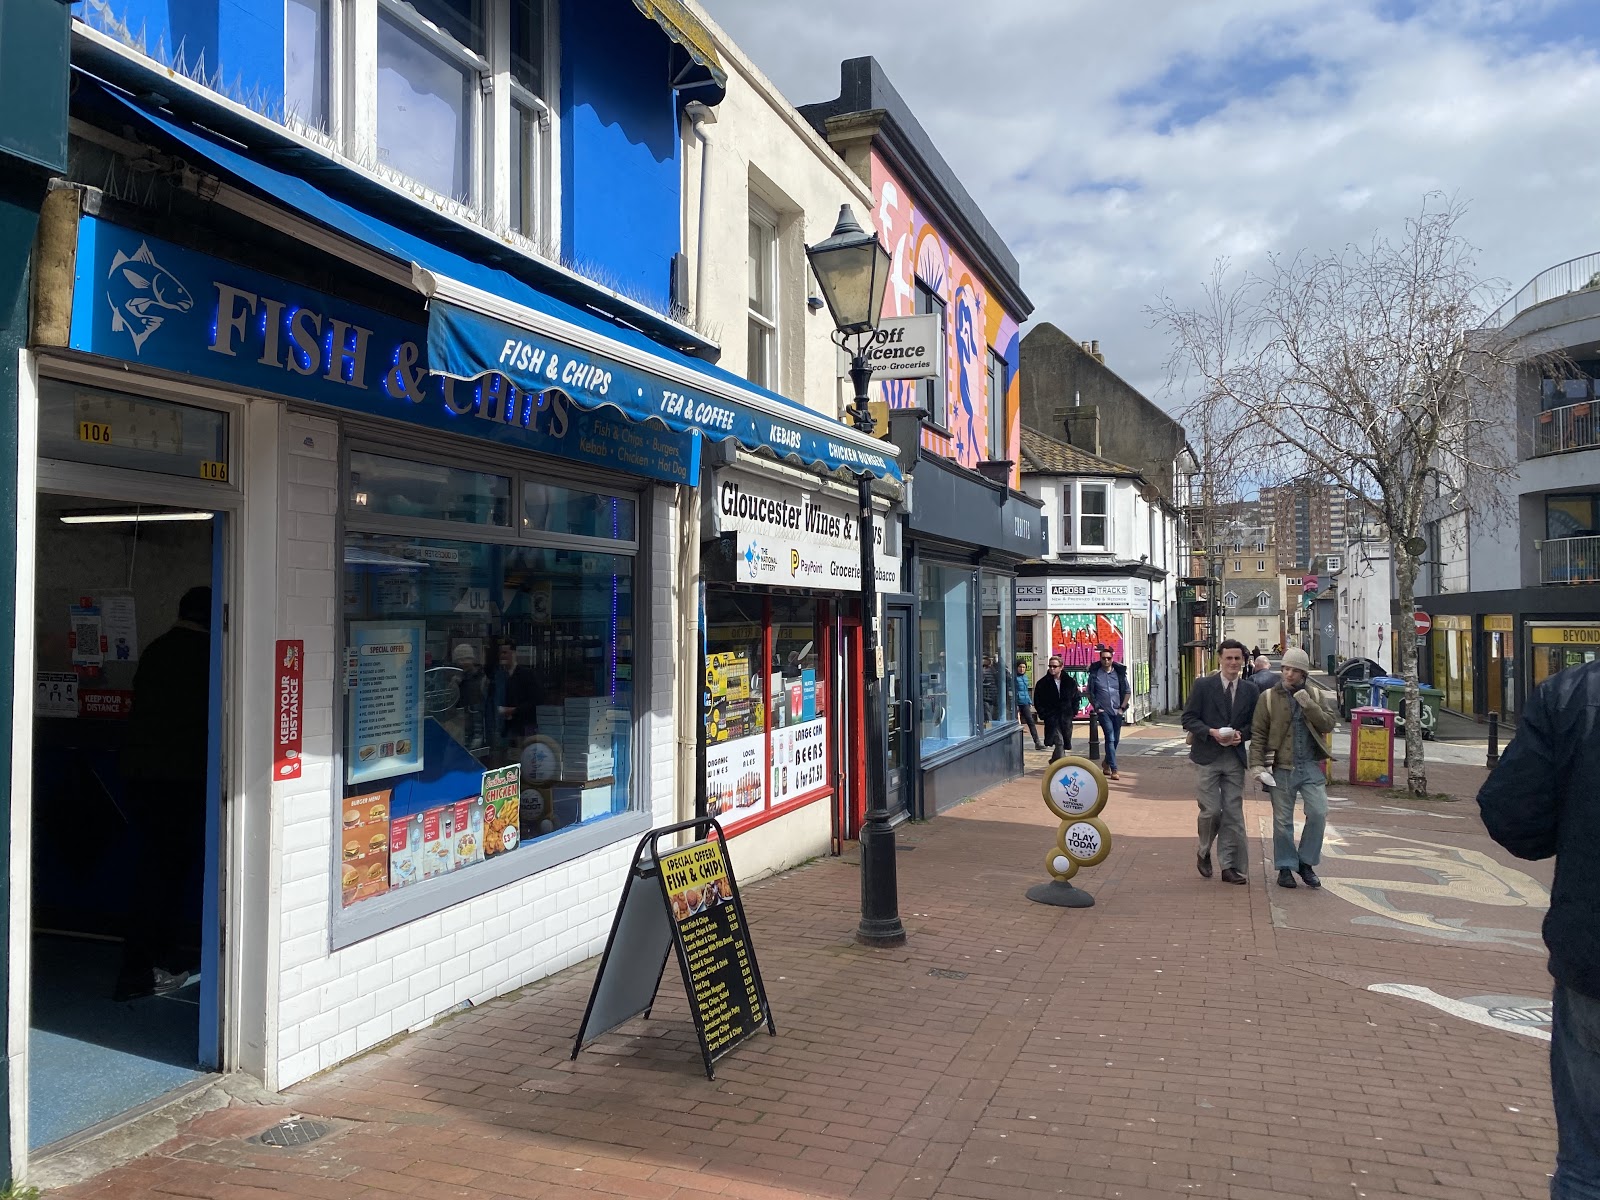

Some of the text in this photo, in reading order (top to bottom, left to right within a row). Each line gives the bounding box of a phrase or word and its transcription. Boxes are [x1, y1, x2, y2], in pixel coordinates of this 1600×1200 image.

[208, 281, 374, 390] FISH
[387, 341, 429, 404] &
[875, 327, 905, 344] Off
[861, 345, 925, 360] icence
[500, 339, 612, 395] FISH & CHIPS
[890, 361, 930, 370] Groceries
[660, 391, 682, 417] TEA
[684, 399, 694, 420] &
[694, 402, 736, 430] COFFEE
[83, 423, 109, 441] 106
[594, 420, 679, 457] Fish & Chips Burgers
[770, 424, 801, 449] KEBABS
[580, 437, 687, 480] Kebab Chicken Hot Dog
[828, 443, 887, 469] CHICKEN BURGERS
[203, 463, 225, 479] 106
[721, 481, 801, 530] Gloucester
[804, 503, 840, 538] Wines
[843, 513, 852, 541] &
[801, 560, 823, 575] PayPoint
[830, 561, 896, 582] Grocerie obacco
[1053, 586, 1084, 594] ACROSS
[1563, 629, 1600, 642] BEYOND
[370, 645, 405, 654] SPECIAL OFFER
[85, 695, 121, 704] KEEP YOUR
[86, 704, 120, 713] DISTANCE
[280, 675, 291, 745] KEEP YOUR
[289, 678, 299, 740] DISTANCE
[796, 724, 823, 742] LARGE CAN
[708, 756, 729, 768] ORGANIC
[743, 748, 756, 758] LOCAL
[796, 742, 823, 766] BEERS
[708, 766, 729, 778] WINES
[743, 758, 756, 768] ALES
[486, 783, 518, 803] CHICKEN
[1068, 838, 1098, 850] TODAY
[1072, 832, 1094, 843] PLAY
[667, 848, 716, 871] SPECIAL OFFERS
[666, 859, 723, 891] FISH & CHIPS
